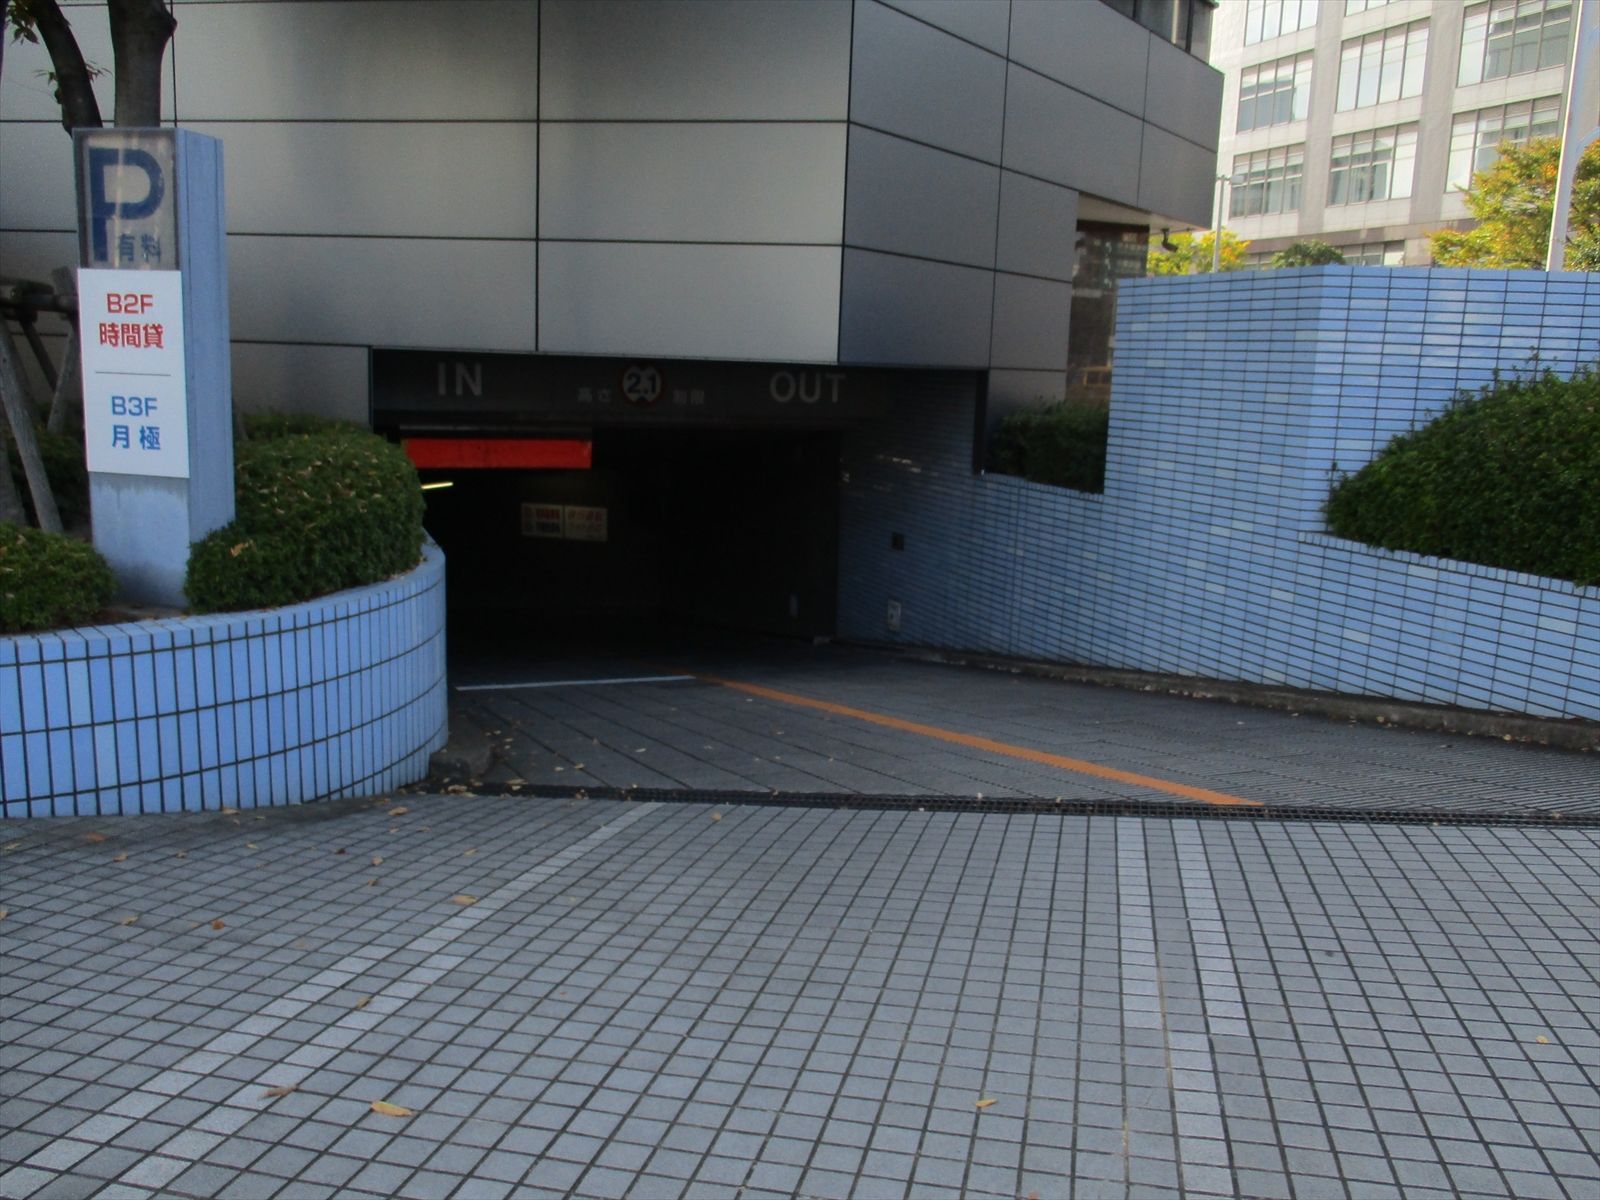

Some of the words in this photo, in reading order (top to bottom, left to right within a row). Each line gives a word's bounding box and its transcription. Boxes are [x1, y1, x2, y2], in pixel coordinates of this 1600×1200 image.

[89, 147, 165, 262] P
[117, 233, 161, 261] 有料
[107, 294, 152, 313] B2F
[99, 323, 164, 348] 時間貸
[437, 362, 482, 396] IN
[769, 372, 846, 404] OUT
[112, 396, 157, 416] B3F
[112, 425, 160, 450] 月極
